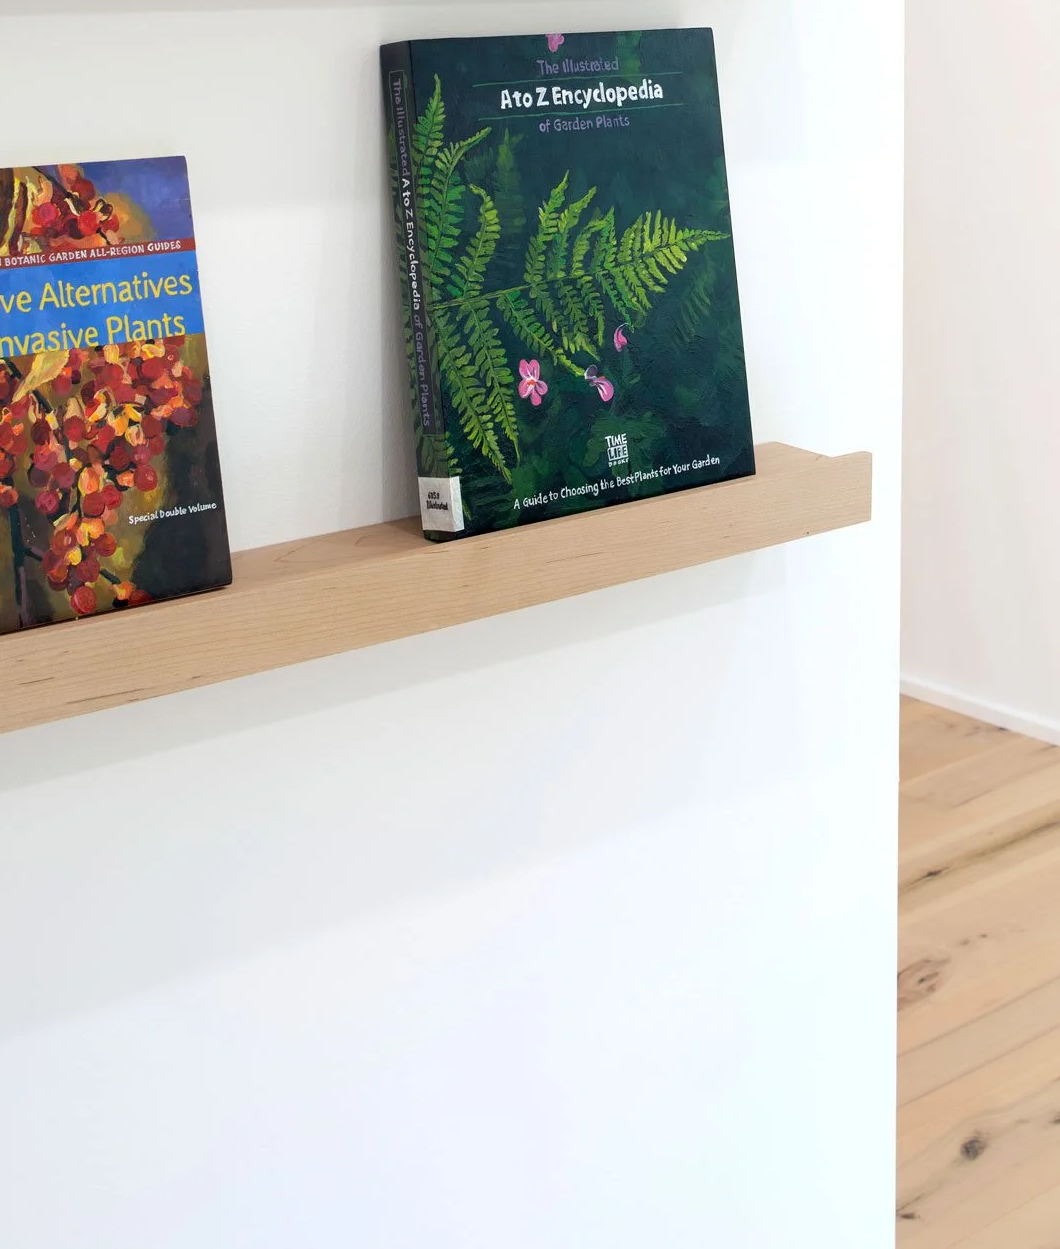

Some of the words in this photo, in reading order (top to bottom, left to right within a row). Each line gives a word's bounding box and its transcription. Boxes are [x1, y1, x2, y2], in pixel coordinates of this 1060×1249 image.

[537, 59, 559, 75] The
[562, 56, 620, 74] Illustrated
[393, 79, 401, 105] The
[500, 89, 513, 109] A
[513, 91, 533, 108] to
[536, 86, 549, 107] Z
[552, 79, 663, 109] Encyclopedia
[539, 119, 551, 133] of
[553, 117, 593, 132] Garden
[596, 115, 630, 129] Plants
[395, 107, 411, 178] Illustrated
[401, 178, 410, 189] A
[402, 190, 410, 206] to
[405, 209, 413, 221] Z
[4, 254, 46, 266] BOTANIC
[49, 250, 87, 262] GARDEN
[90, 244, 144, 258] ALL-REGION
[147, 240, 181, 252] GUIDES
[406, 222, 421, 311] Encyclopedia
[39, 271, 193, 311] Alternatives
[106, 312, 186, 344] Plants
[414, 313, 423, 329] of
[415, 332, 426, 381] Garden
[421, 383, 431, 426] Plants
[605, 433, 628, 447] TIME
[608, 445, 628, 460] LIFE
[513, 498, 521, 510] A
[523, 493, 549, 508] Guide
[549, 490, 559, 501] to
[560, 482, 599, 498] Choosing
[600, 478, 615, 490] the
[616, 474, 634, 487] Best
[634, 468, 658, 482] Plants
[659, 465, 672, 477] for
[673, 463, 691, 475] Your
[692, 454, 720, 469] Garden
[128, 510, 158, 525] Special
[159, 506, 187, 519] Double
[188, 501, 218, 513] Volume
